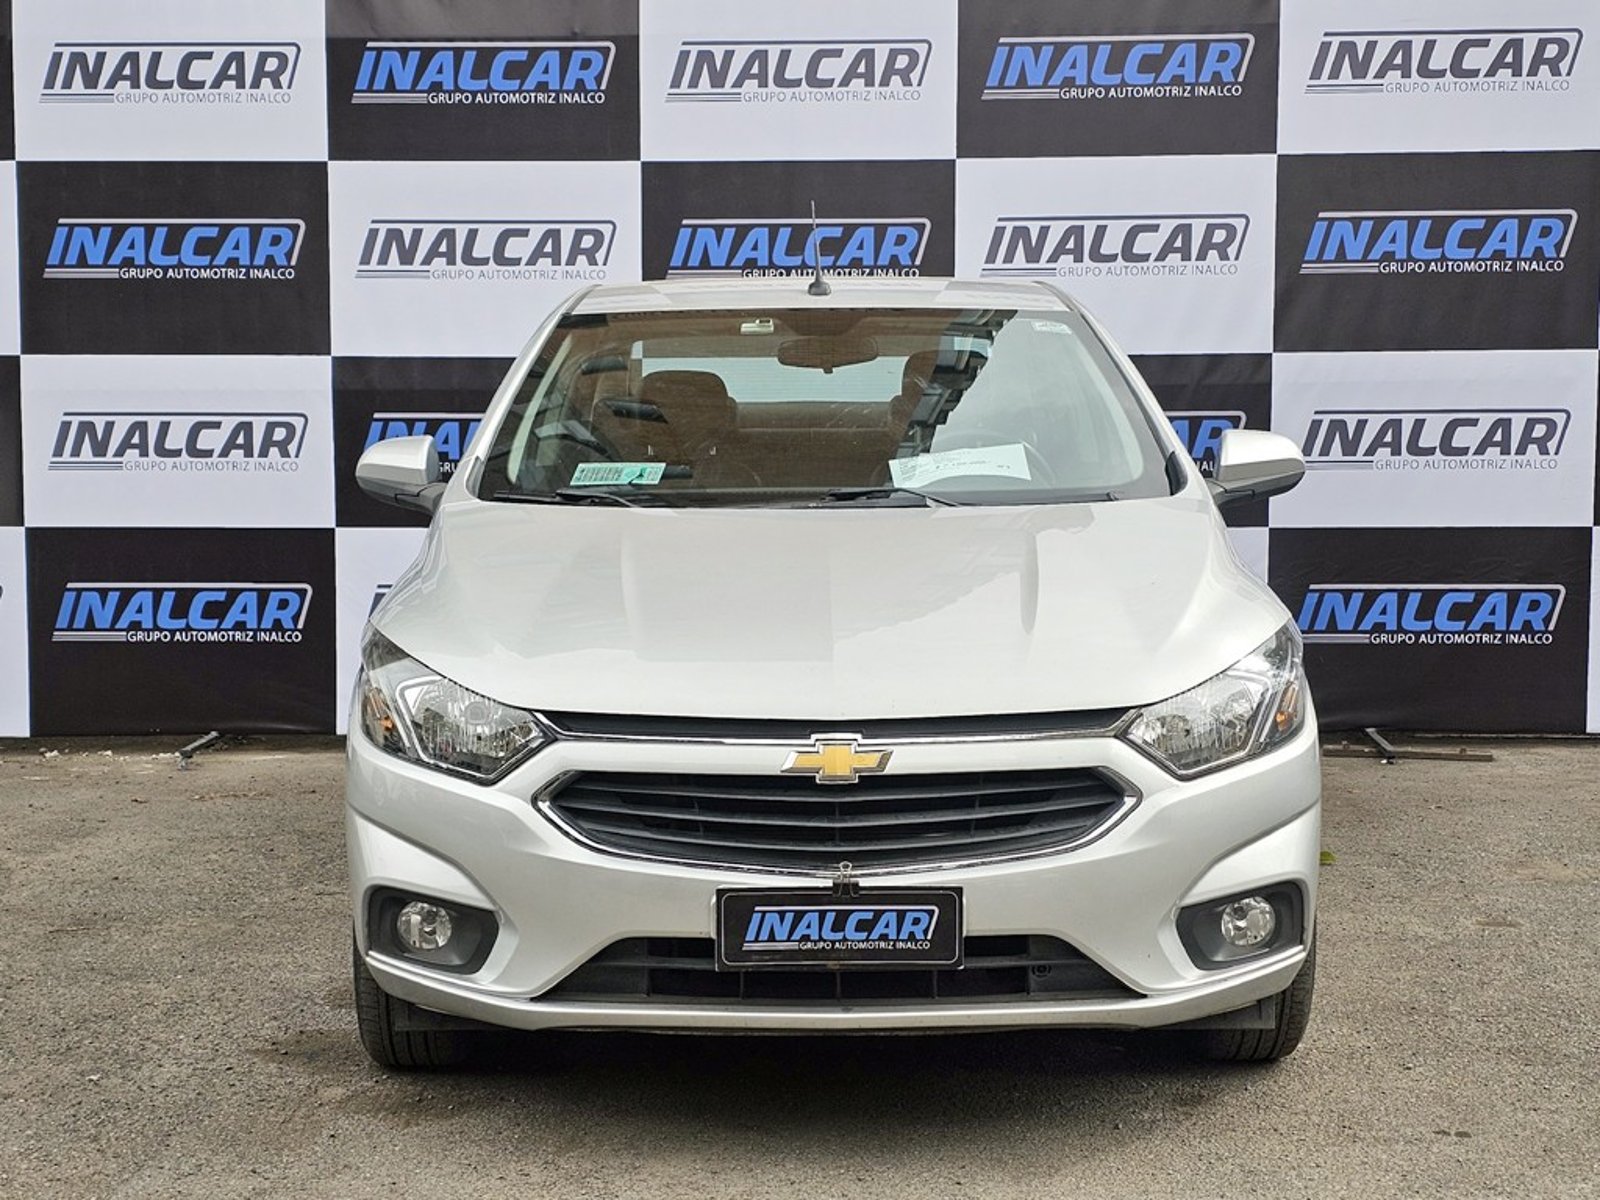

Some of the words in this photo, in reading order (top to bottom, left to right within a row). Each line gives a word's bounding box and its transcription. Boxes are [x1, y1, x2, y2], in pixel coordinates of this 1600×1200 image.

[44, 50, 289, 90] INALCAR
[355, 50, 603, 91] INALCAR
[672, 49, 921, 88] INALCAR
[986, 42, 1241, 86] INALCAR
[1311, 37, 1571, 80] INALCAR
[116, 92, 157, 104] GRUPO
[162, 92, 240, 104] AUTOMOTRIZ
[247, 92, 291, 104] INALCO
[428, 92, 471, 104] GRUPO
[475, 92, 554, 104] AUTOMOTRIZ
[558, 92, 605, 104] INALCO
[743, 90, 785, 102] GRUPO
[789, 90, 869, 102] AUTOMOTRIZ
[875, 90, 920, 102] INALCO
[1060, 87, 1104, 99] GRUPO
[1108, 86, 1190, 98] AUTOMOTRIZ
[1195, 85, 1242, 97] INALCO
[1385, 82, 1428, 94] GRUPO
[1434, 81, 1516, 93] AUTOMOTRIZ
[1522, 79, 1570, 91] INALCO
[48, 226, 293, 266] INALCAR
[359, 227, 603, 267] INALCAR
[669, 226, 919, 266] INALCAR
[986, 222, 1237, 263] INALCAR
[1303, 217, 1565, 261] INALCAR
[120, 267, 162, 279] GRUPO
[166, 267, 245, 279] AUTOMOTRIZ
[250, 267, 294, 279] INALCO
[432, 268, 473, 280] GRUPO
[478, 268, 556, 280] AUTOMOTRIZ
[562, 268, 606, 280] INALCO
[1057, 265, 1102, 277] GRUPO
[1106, 264, 1186, 276] AUTOMOTRIZ
[1192, 263, 1238, 275] INALCO
[1379, 261, 1424, 274] GRUPO
[1428, 260, 1511, 273] AUTOMOTRIZ
[1517, 259, 1564, 272] INALCO
[52, 420, 295, 459] INALCAR
[1302, 418, 1558, 457] INALCAR
[125, 460, 165, 472] GRUPO
[171, 460, 248, 472] AUTOMOTRIZ
[255, 460, 299, 472] INALCO
[1375, 458, 1418, 470] GRUPO
[1423, 458, 1505, 470] AUTOMOTRIZ
[1509, 458, 1557, 470] INALCO
[55, 591, 301, 630] INALCAR
[1298, 591, 1552, 631] INALCAR
[127, 631, 169, 642] GRUPO
[174, 631, 252, 642] AUTOMOTRIZ
[257, 631, 302, 642] INALCO
[1371, 633, 1414, 644] GRUPO
[1419, 633, 1501, 644] AUTOMOTRIZ
[1506, 633, 1553, 644] INALCO
[745, 911, 929, 941] INALCAR
[800, 941, 831, 950] GRUPO
[834, 941, 893, 950] AUTOMOTRIZ
[896, 941, 930, 950] INALCO
